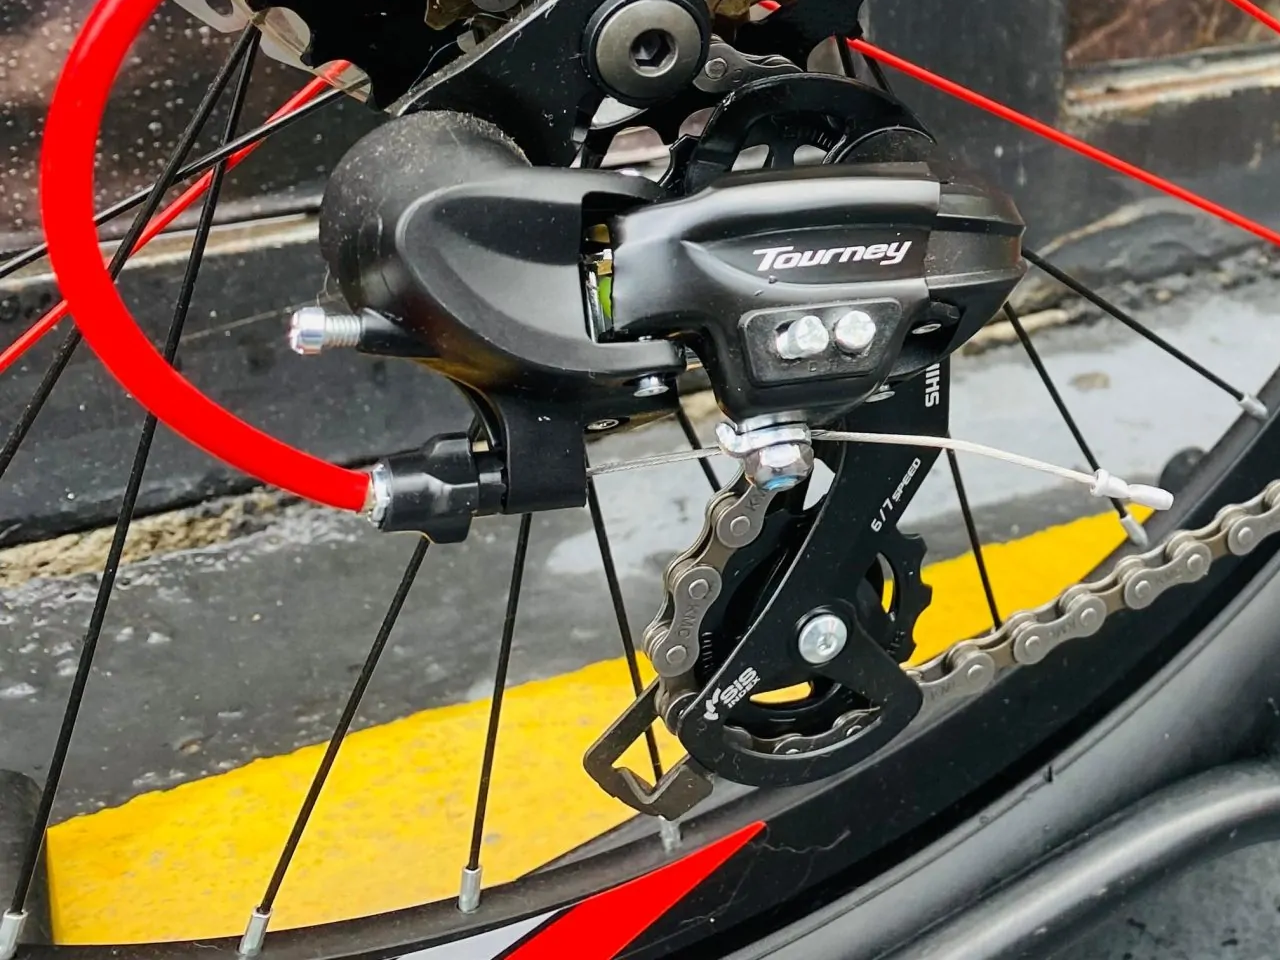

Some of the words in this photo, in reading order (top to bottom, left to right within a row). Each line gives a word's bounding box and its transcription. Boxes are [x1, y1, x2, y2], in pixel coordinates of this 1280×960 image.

[752, 240, 913, 272] Tourney
[891, 457, 921, 502] SPEED
[677, 603, 700, 640] KMC
[719, 666, 757, 705] SIS
[727, 675, 761, 709] INDEX
